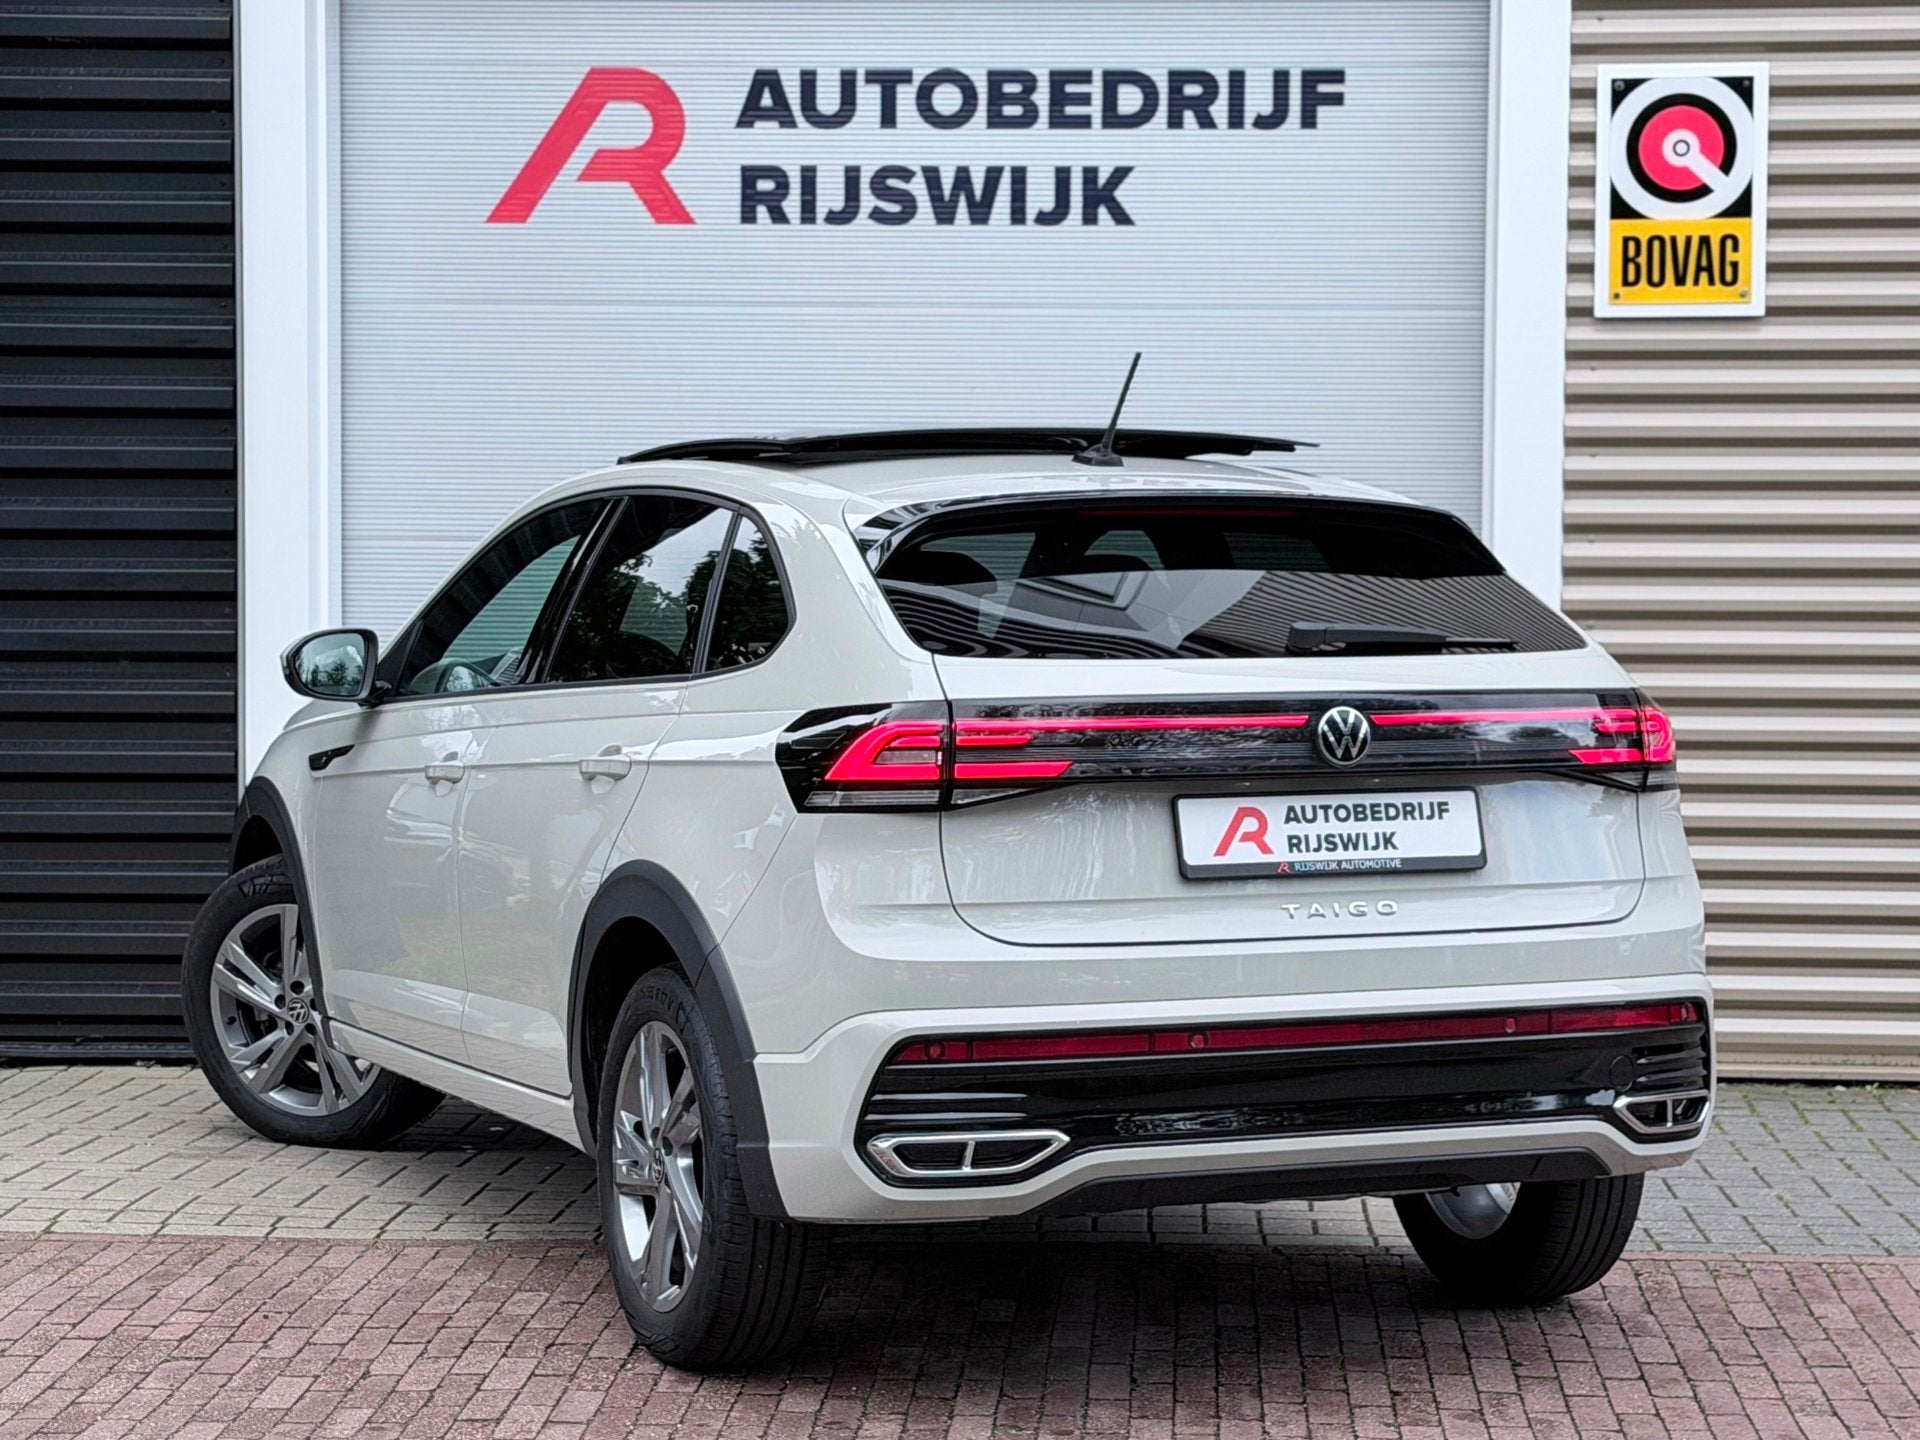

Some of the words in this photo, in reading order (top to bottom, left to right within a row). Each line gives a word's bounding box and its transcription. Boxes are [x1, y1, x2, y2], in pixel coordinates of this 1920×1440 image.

[736, 67, 1346, 130] AUTOBEDRIJF
[740, 164, 1136, 226] RIJSWIJK
[1621, 233, 1740, 288] BOVAG
[1283, 800, 1450, 825] AUTOBEDRIJF
[1287, 831, 1399, 853] RIJSWIJK
[1294, 860, 1339, 872] RIJSWIJK
[1341, 858, 1402, 870] AUTOMOTIVE
[1280, 900, 1399, 920] TAIGO
